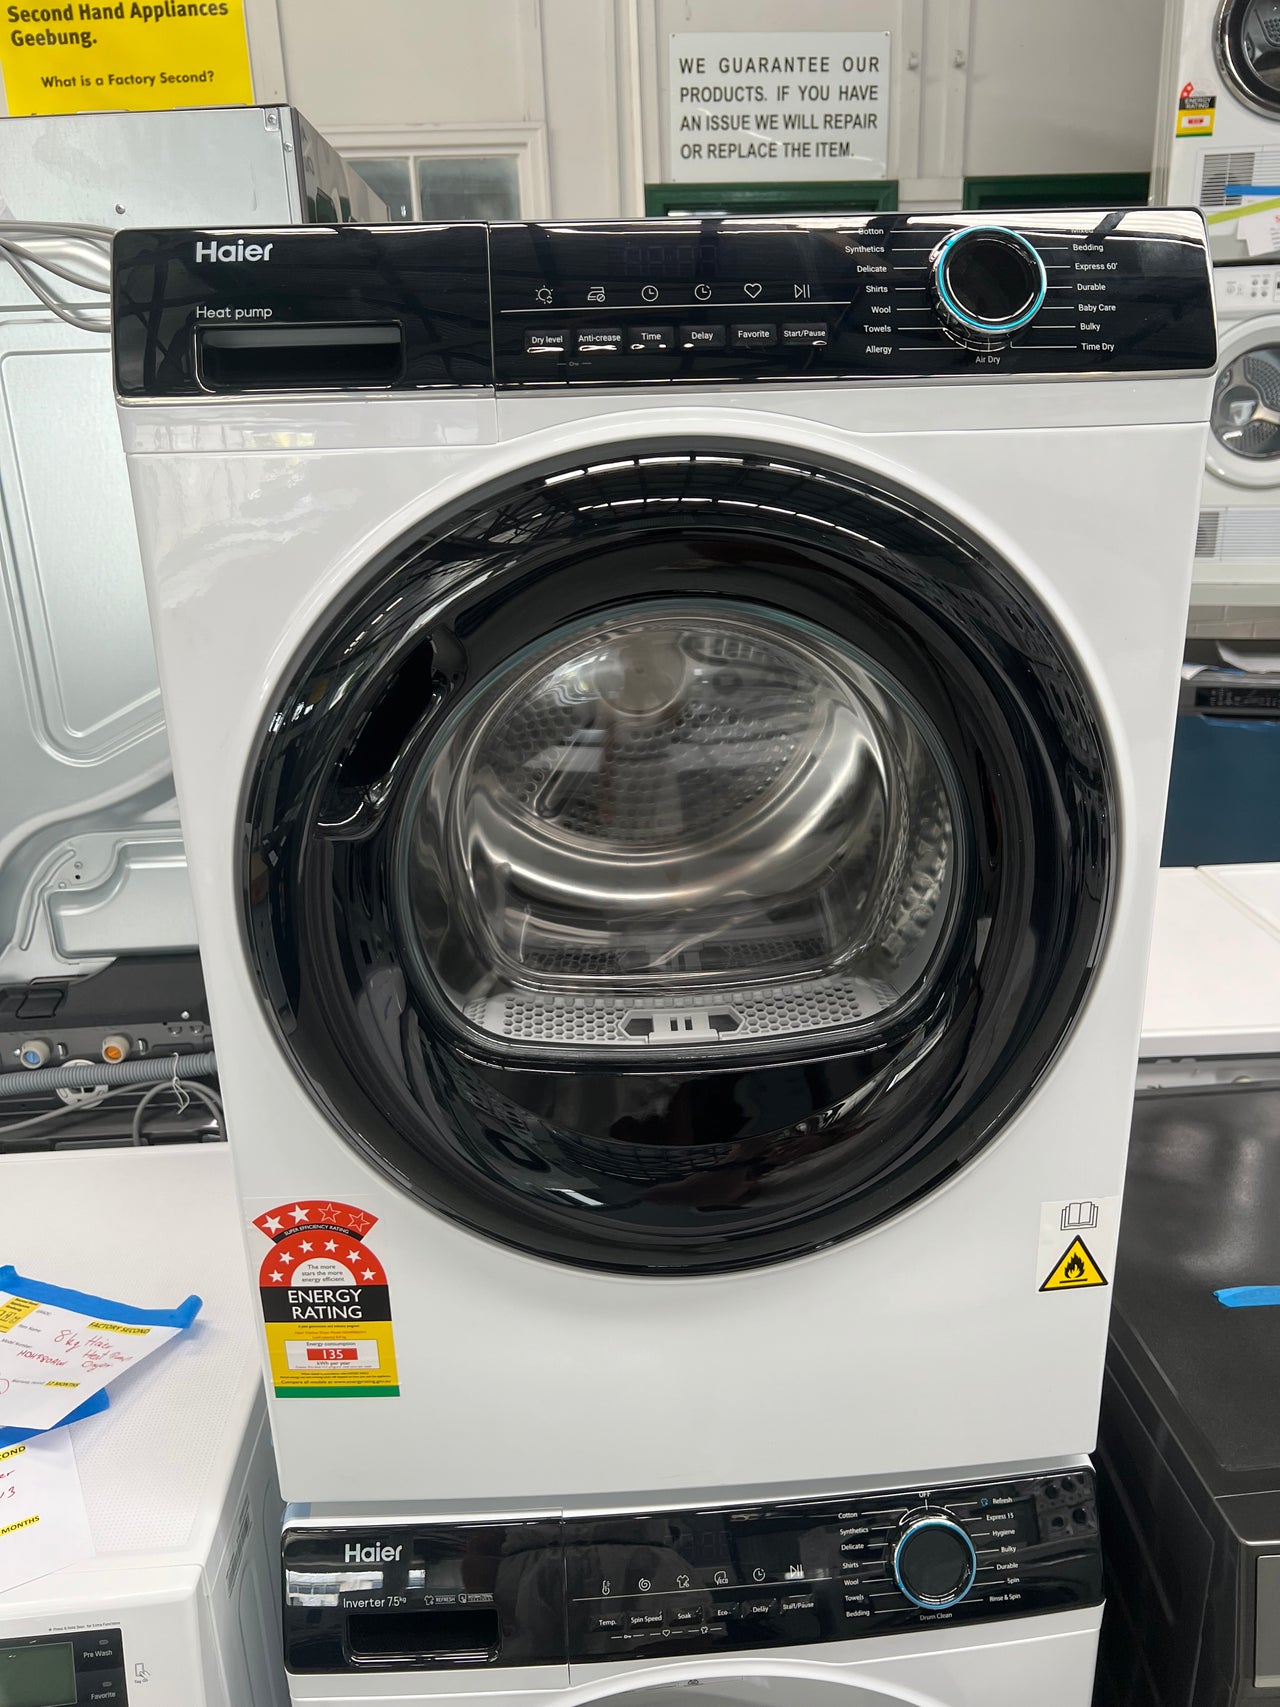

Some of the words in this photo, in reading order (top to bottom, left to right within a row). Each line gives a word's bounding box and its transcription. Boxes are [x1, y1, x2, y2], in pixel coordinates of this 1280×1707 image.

[8, 5, 74, 23] Second
[80, 3, 125, 21] Hand
[130, 0, 229, 23] Appliances
[11, 29, 97, 48] Geebung.
[680, 57, 706, 74] WE
[719, 56, 830, 73] GUARANTEE
[842, 56, 880, 72] OUR
[41, 74, 77, 88] What
[80, 75, 91, 87] is
[95, 78, 104, 86] a
[108, 73, 155, 88] Factory
[160, 70, 215, 84] Second?
[680, 85, 767, 103] PRODUCTS.
[777, 85, 790, 101] IF
[798, 85, 830, 101] YOU
[838, 85, 878, 101] HAVE
[680, 115, 701, 131] AN
[706, 114, 750, 131] ISSUE
[755, 114, 778, 130] WE
[783, 113, 819, 130] WILL
[823, 113, 877, 129] REPAIR
[680, 144, 702, 160] OR
[707, 142, 778, 159] REPLACE
[783, 142, 811, 157] THE
[815, 142, 855, 157] ITEM.
[857, 227, 884, 236] Cotton
[195, 239, 274, 263] Haier
[845, 245, 885, 254] Synthetics
[1073, 243, 1104, 253] Bedding
[856, 265, 887, 273] Delicate
[1075, 263, 1106, 272] Express
[865, 285, 888, 293] Shirts
[1077, 283, 1106, 291] Durable
[871, 306, 891, 314] Wool
[1078, 304, 1097, 312] Baby
[1098, 303, 1117, 311] Care
[196, 306, 232, 318] Heat
[235, 307, 273, 320] pump
[863, 325, 892, 333] Towels
[1080, 323, 1101, 332] Bulky
[578, 332, 621, 343] Anti-crease
[641, 332, 661, 341] Time
[691, 331, 714, 342] Delay
[738, 330, 770, 339] Favorite
[783, 328, 826, 338] Start/Pause
[531, 335, 545, 345] Dry
[545, 334, 563, 344] level
[865, 345, 892, 355] Allergy
[1081, 343, 1099, 351] Time
[1100, 343, 1115, 352] Dry
[975, 356, 986, 364] Air
[986, 356, 1000, 365] Dry
[288, 1289, 362, 1304] ENERGY
[292, 1305, 363, 1319] RATING
[88, 1322, 120, 1332] FACTORY
[119, 1326, 150, 1335] SECOND
[322, 1349, 344, 1359] 135
[0, 1445, 26, 1460] OND
[986, 1513, 1006, 1521] Express
[1, 1515, 40, 1534] MONTHS
[839, 1527, 869, 1535] Synthetics
[992, 1528, 1016, 1537] Hygiene
[344, 1542, 403, 1563] Haier
[996, 1562, 1018, 1570] Durable
[1008, 1593, 1021, 1601] Spin
[343, 1597, 385, 1609] Inverter
[782, 1601, 815, 1610] Start/Pause
[752, 1606, 769, 1614] Delay
[846, 1609, 870, 1618] Bedding
[599, 1619, 617, 1627] Temp.
[630, 1616, 644, 1624] Spin
[645, 1615, 662, 1623] Speed
[95, 1650, 113, 1658] Wash
[91, 1692, 116, 1700] Favorite
